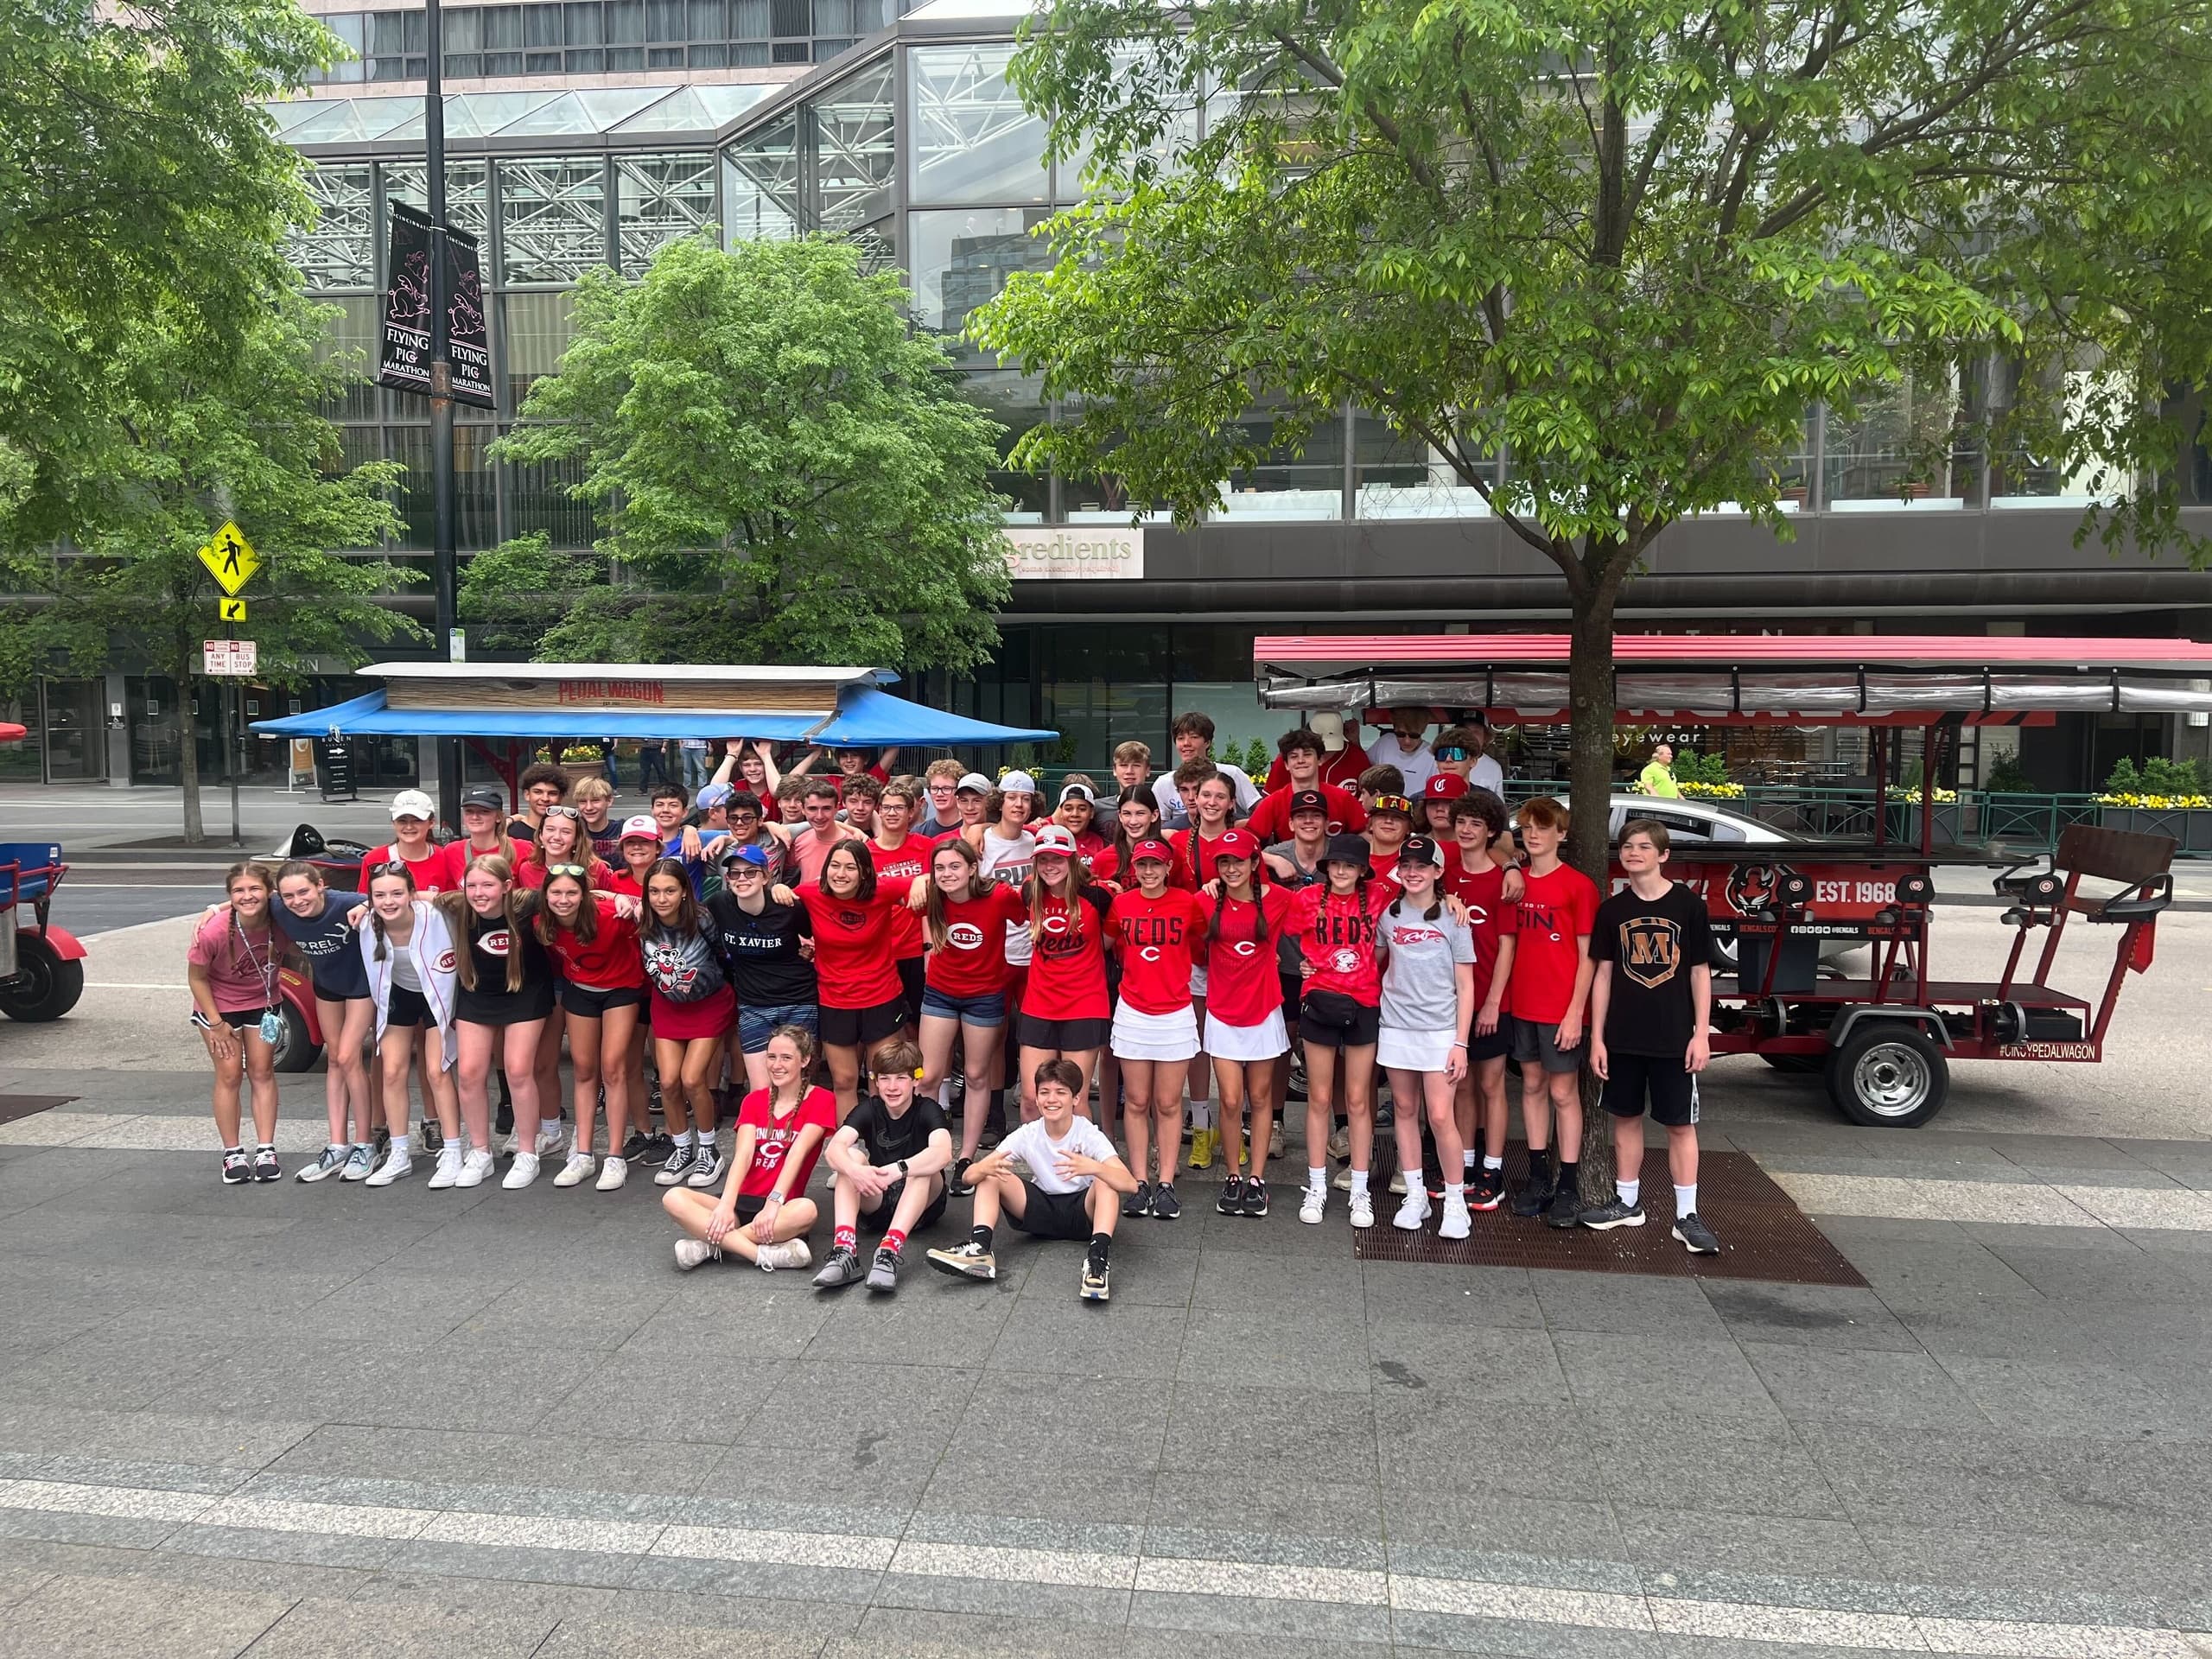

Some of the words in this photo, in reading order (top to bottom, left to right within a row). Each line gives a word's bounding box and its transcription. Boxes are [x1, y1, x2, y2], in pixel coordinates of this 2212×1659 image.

[386, 327, 429, 350] FLYING
[395, 346, 418, 364] PIG
[451, 346, 487, 365] FLYING
[383, 360, 429, 378] MARATHON
[461, 363, 480, 378] PIG
[452, 377, 490, 392] MARATHON
[559, 680, 605, 705] PEDAL
[607, 681, 664, 703] WAGON
[1816, 880, 1851, 903] EST.
[1855, 881, 1896, 903] 1968
[842, 913, 865, 922] REDS
[953, 932, 983, 942] REDS
[1122, 917, 1183, 946] REDS
[1316, 914, 1373, 945] REDS
[724, 932, 736, 945] ST.
[738, 936, 782, 949] XAVIER
[1630, 932, 1670, 964] M
